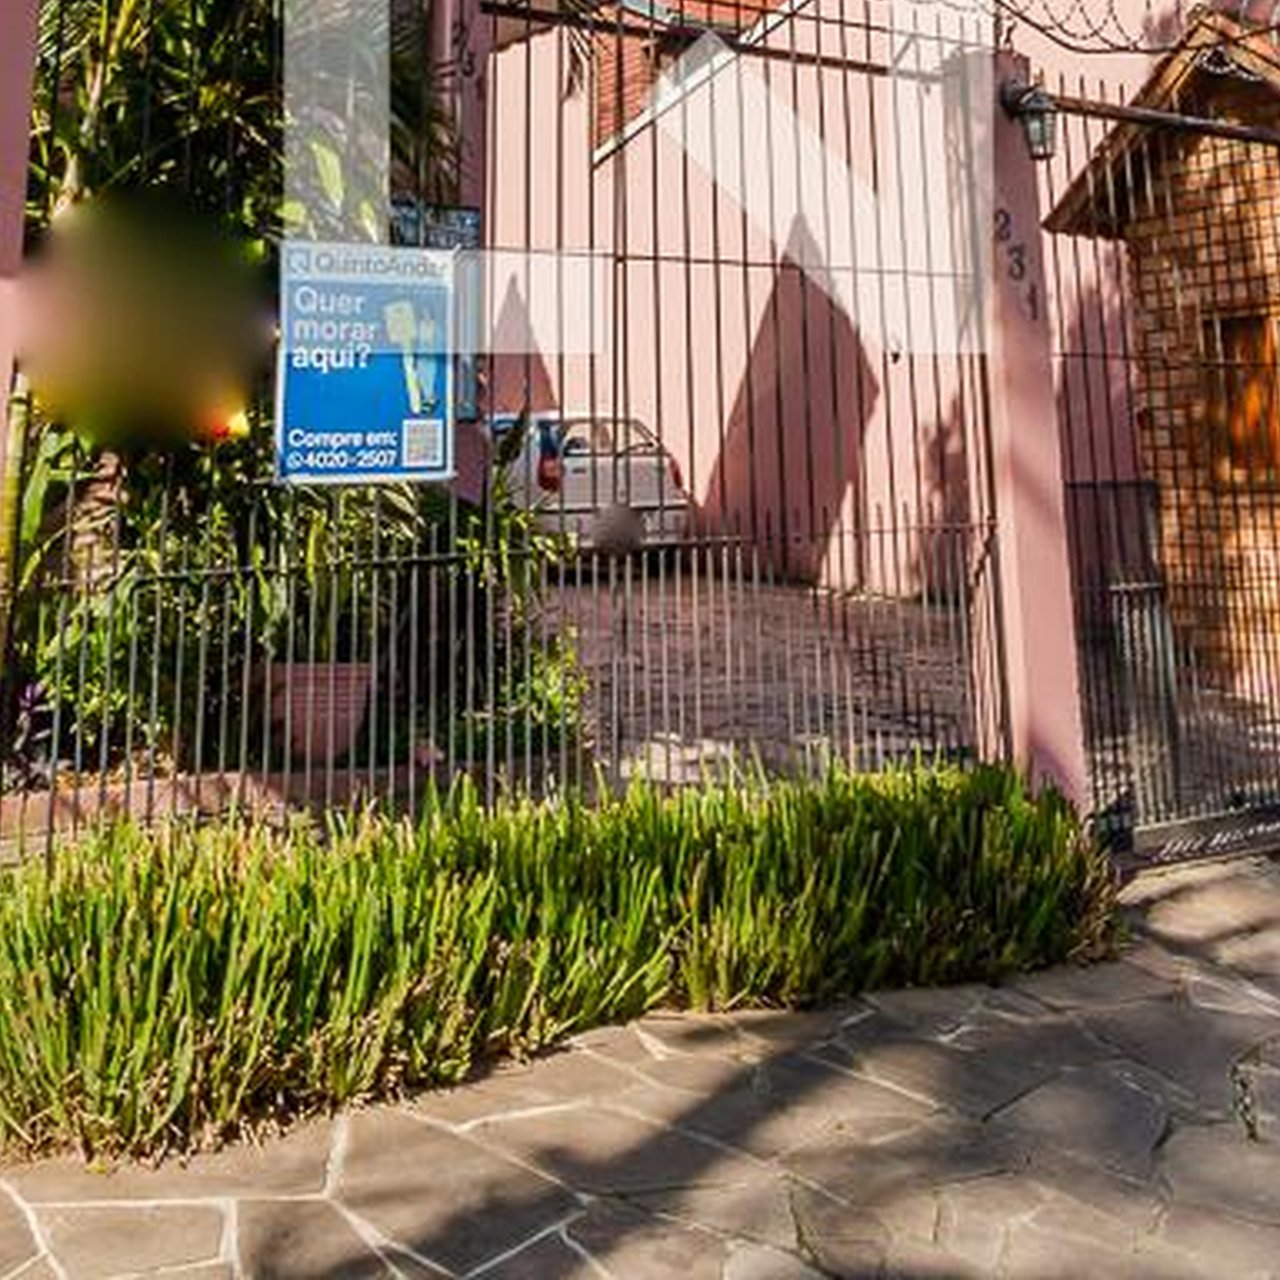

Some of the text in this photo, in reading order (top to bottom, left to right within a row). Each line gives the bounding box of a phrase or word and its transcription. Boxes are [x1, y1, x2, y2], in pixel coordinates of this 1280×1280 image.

[295, 286, 366, 314] Quer
[293, 319, 377, 341] morar
[292, 342, 371, 374] aqui?
[288, 428, 363, 449] Compre
